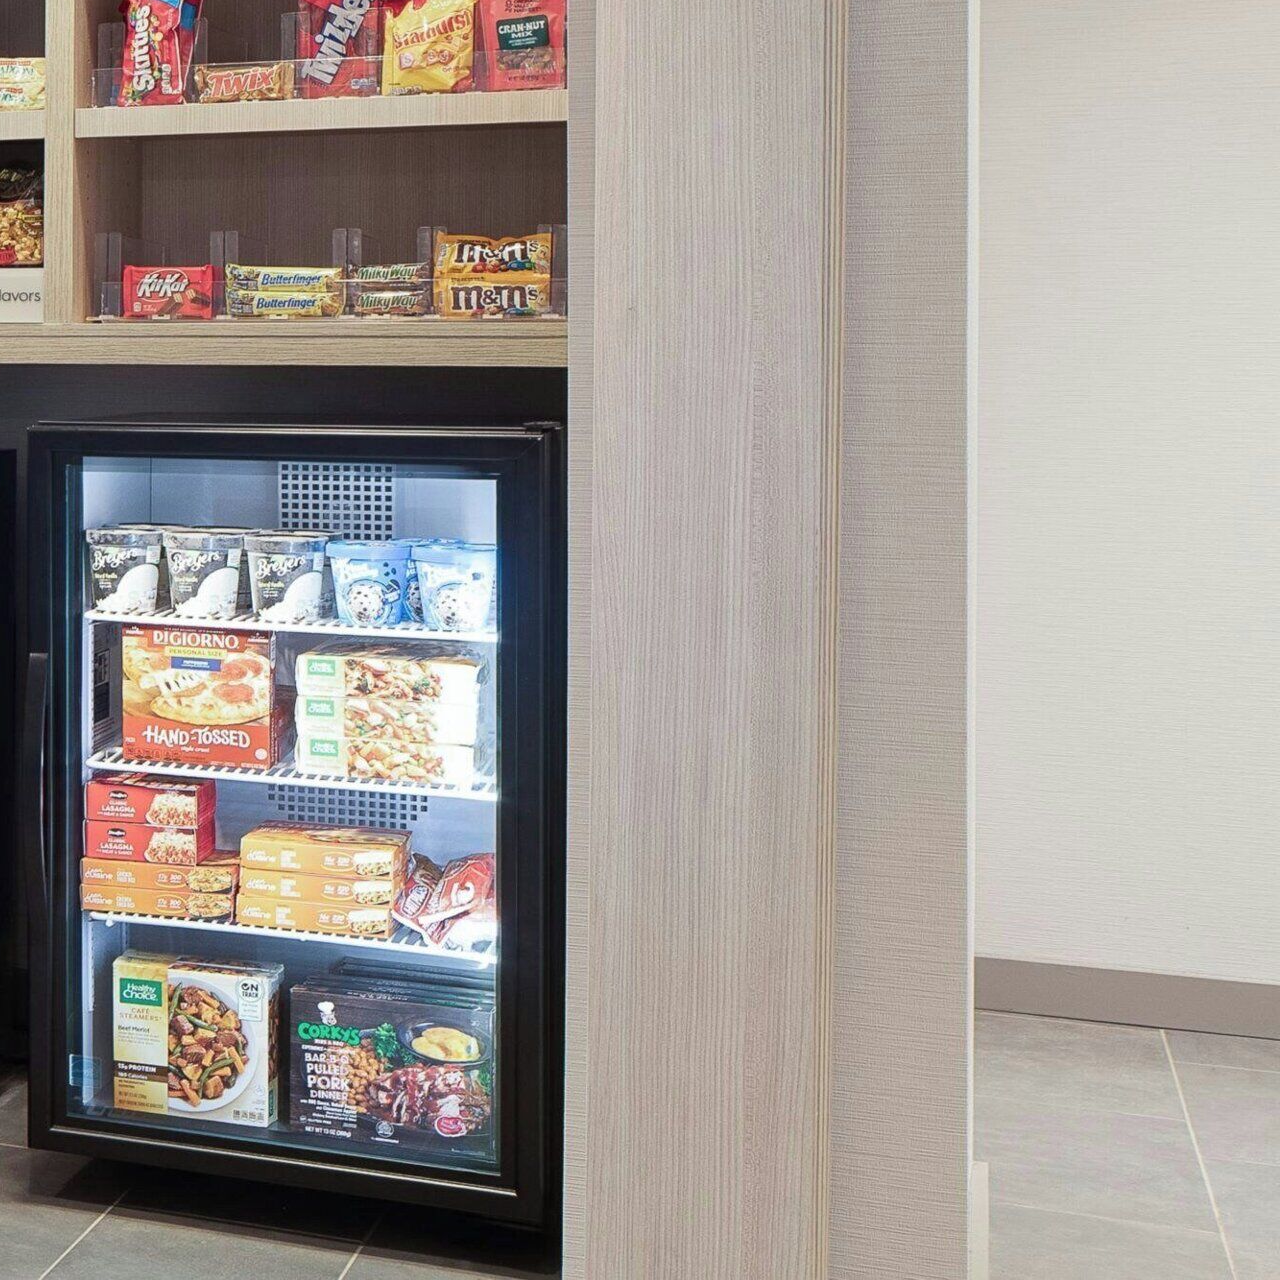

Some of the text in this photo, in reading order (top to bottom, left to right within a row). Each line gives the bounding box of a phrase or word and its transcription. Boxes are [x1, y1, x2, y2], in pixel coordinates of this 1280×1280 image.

[498, 20, 545, 34] CRAN-NUT
[133, 5, 155, 91] Skittles
[207, 67, 275, 98] Twix
[261, 273, 323, 286] Butterfinger
[358, 265, 418, 281] Milky Way
[256, 297, 318, 309] Butterfinger
[358, 293, 418, 309] Milky Way
[451, 284, 539, 311] m&m's
[92, 549, 138, 570] Breyers
[169, 550, 221, 573] Breyers
[256, 555, 306, 579] Breyers
[153, 630, 239, 649] DIGIORNO
[142, 725, 250, 748] HAND-TOSSED
[101, 805, 136, 813] LASAGNA
[100, 842, 134, 850] LASAGNA
[123, 990, 158, 1001] Choice
[127, 983, 156, 993] Healthy
[120, 1012, 161, 1021] STEAMERS
[298, 1022, 361, 1046] CORKY'S
[304, 1052, 349, 1064] BAR-B-Q
[129, 1064, 156, 1072] PROTEIN
[306, 1063, 350, 1075] PULLED
[307, 1074, 351, 1091] PORK
[309, 1089, 349, 1101] DINNER
